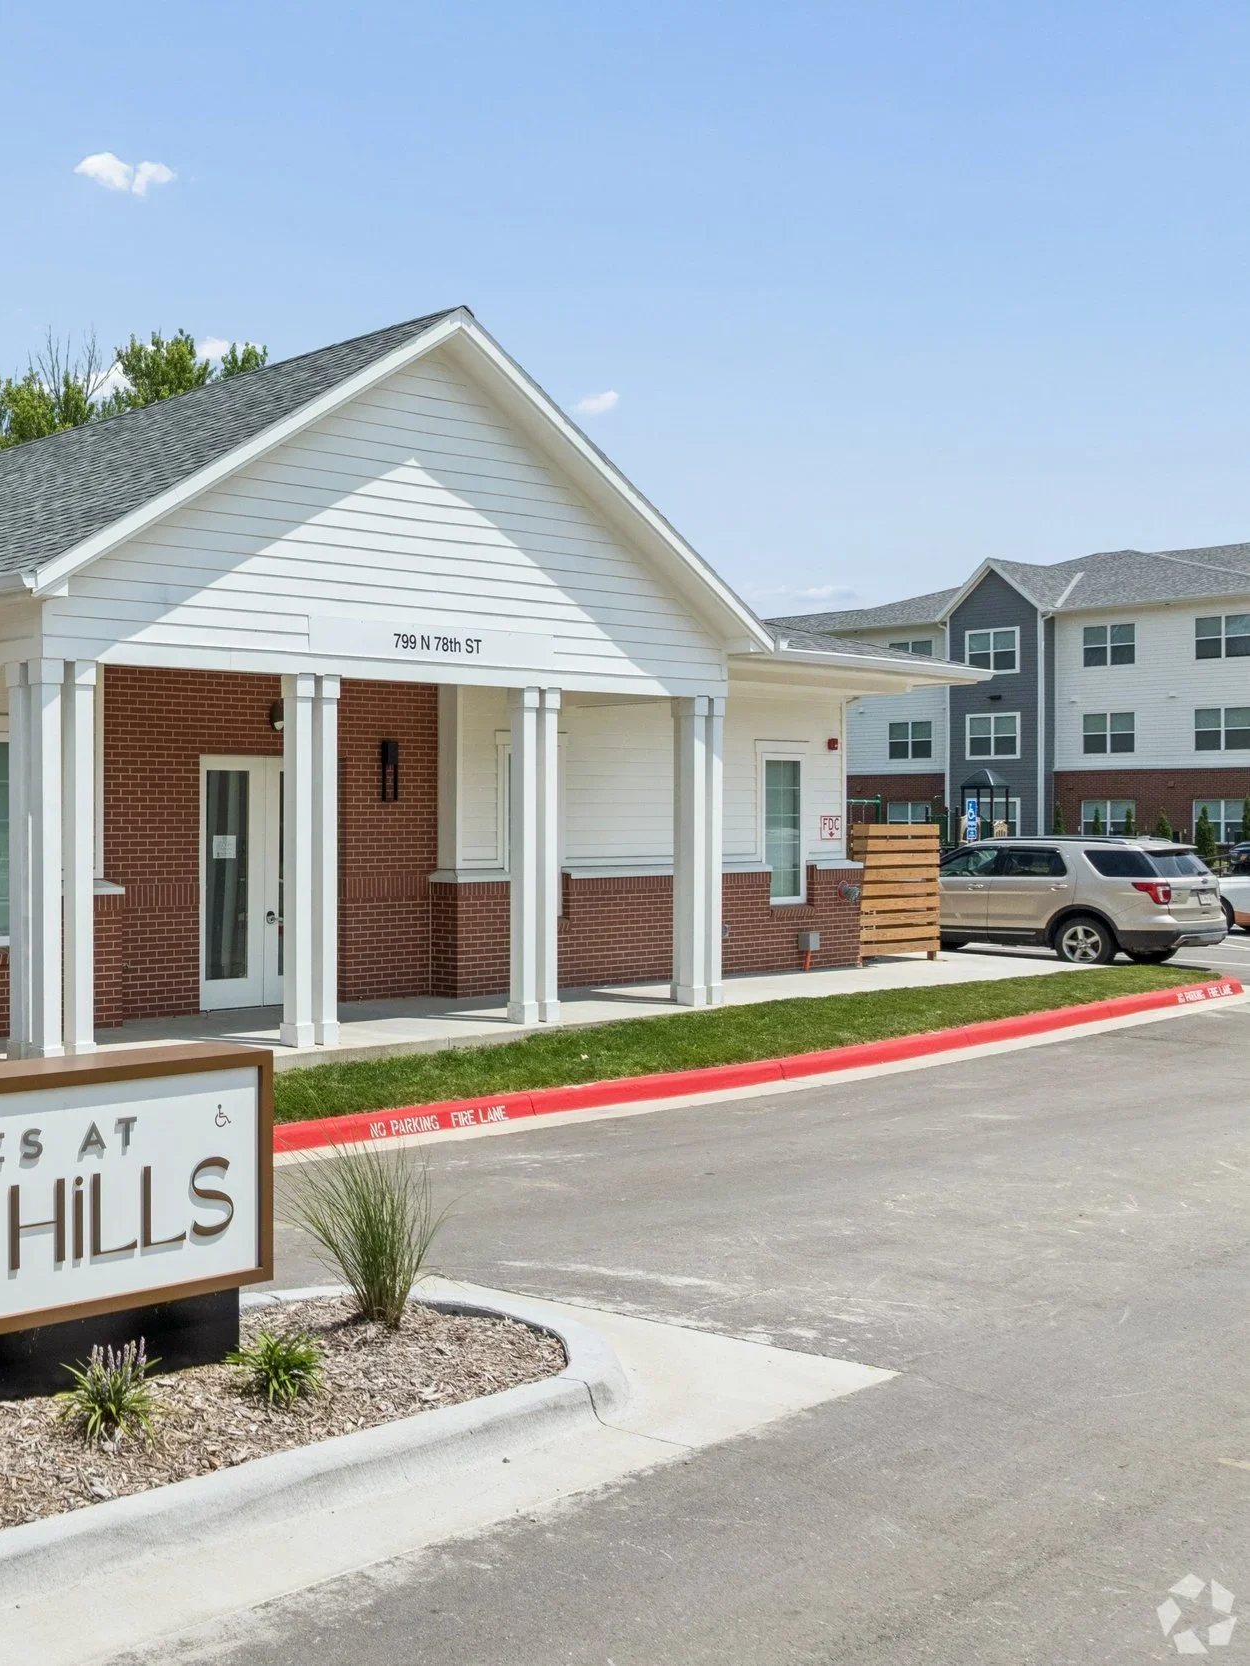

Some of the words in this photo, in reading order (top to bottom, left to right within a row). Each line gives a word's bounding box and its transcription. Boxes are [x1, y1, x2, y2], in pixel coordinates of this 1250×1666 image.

[393, 633, 417, 650] 799
[420, 635, 431, 651] N
[434, 636, 462, 653] 78th
[465, 638, 482, 655] ST
[822, 817, 840, 831] FDC
[80, 1115, 138, 1154] AT
[369, 1122, 386, 1139] NO
[390, 1114, 440, 1136] PARKING
[450, 1108, 476, 1128] FIRE
[478, 1105, 509, 1124] LANE
